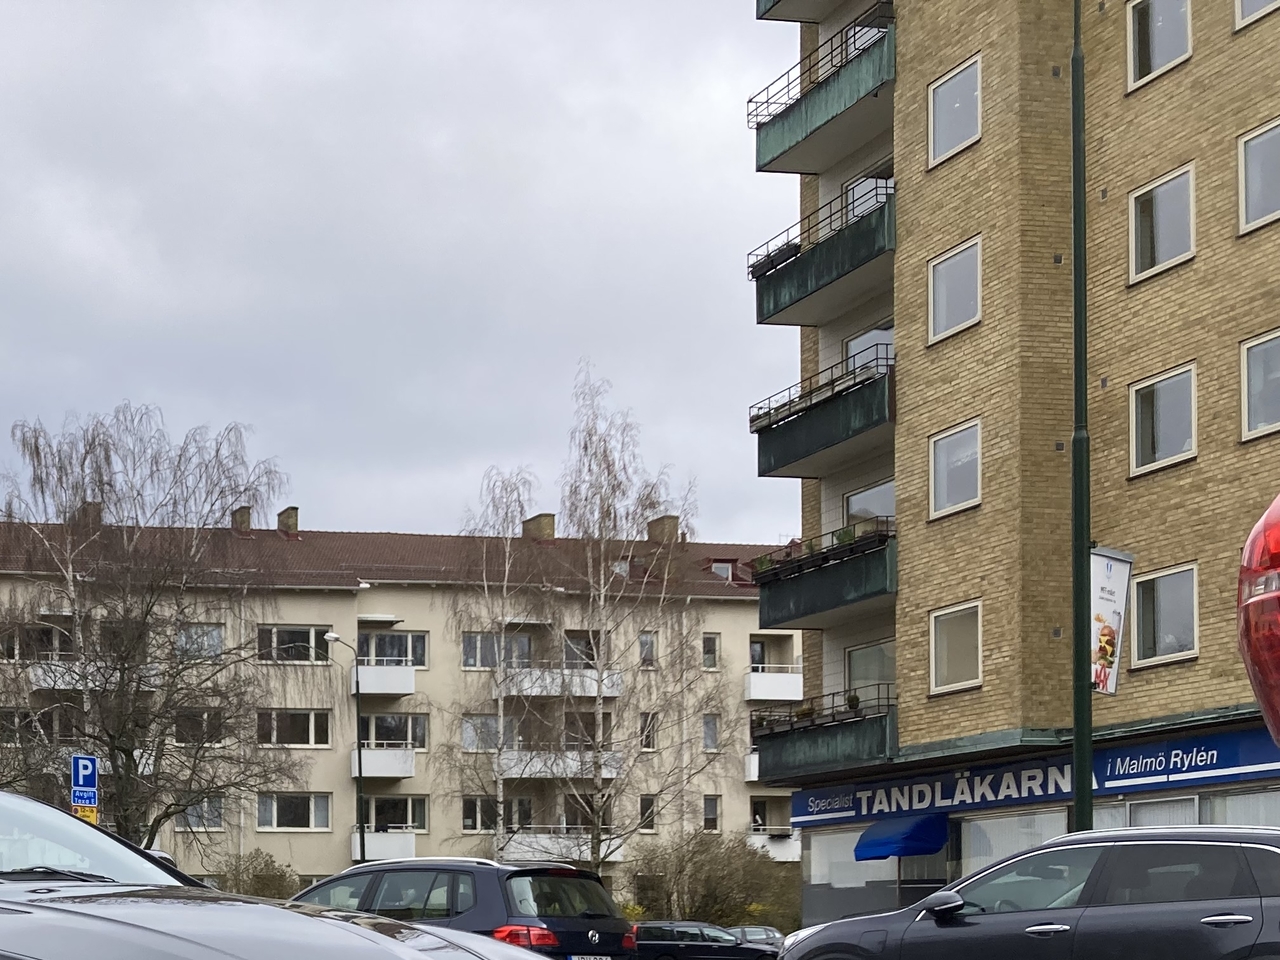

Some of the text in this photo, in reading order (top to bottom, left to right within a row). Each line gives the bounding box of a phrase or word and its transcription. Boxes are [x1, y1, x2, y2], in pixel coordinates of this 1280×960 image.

[78, 758, 93, 785] P
[807, 746, 1218, 816] Specialist TANDLÄKARN i Malmö Rylén
